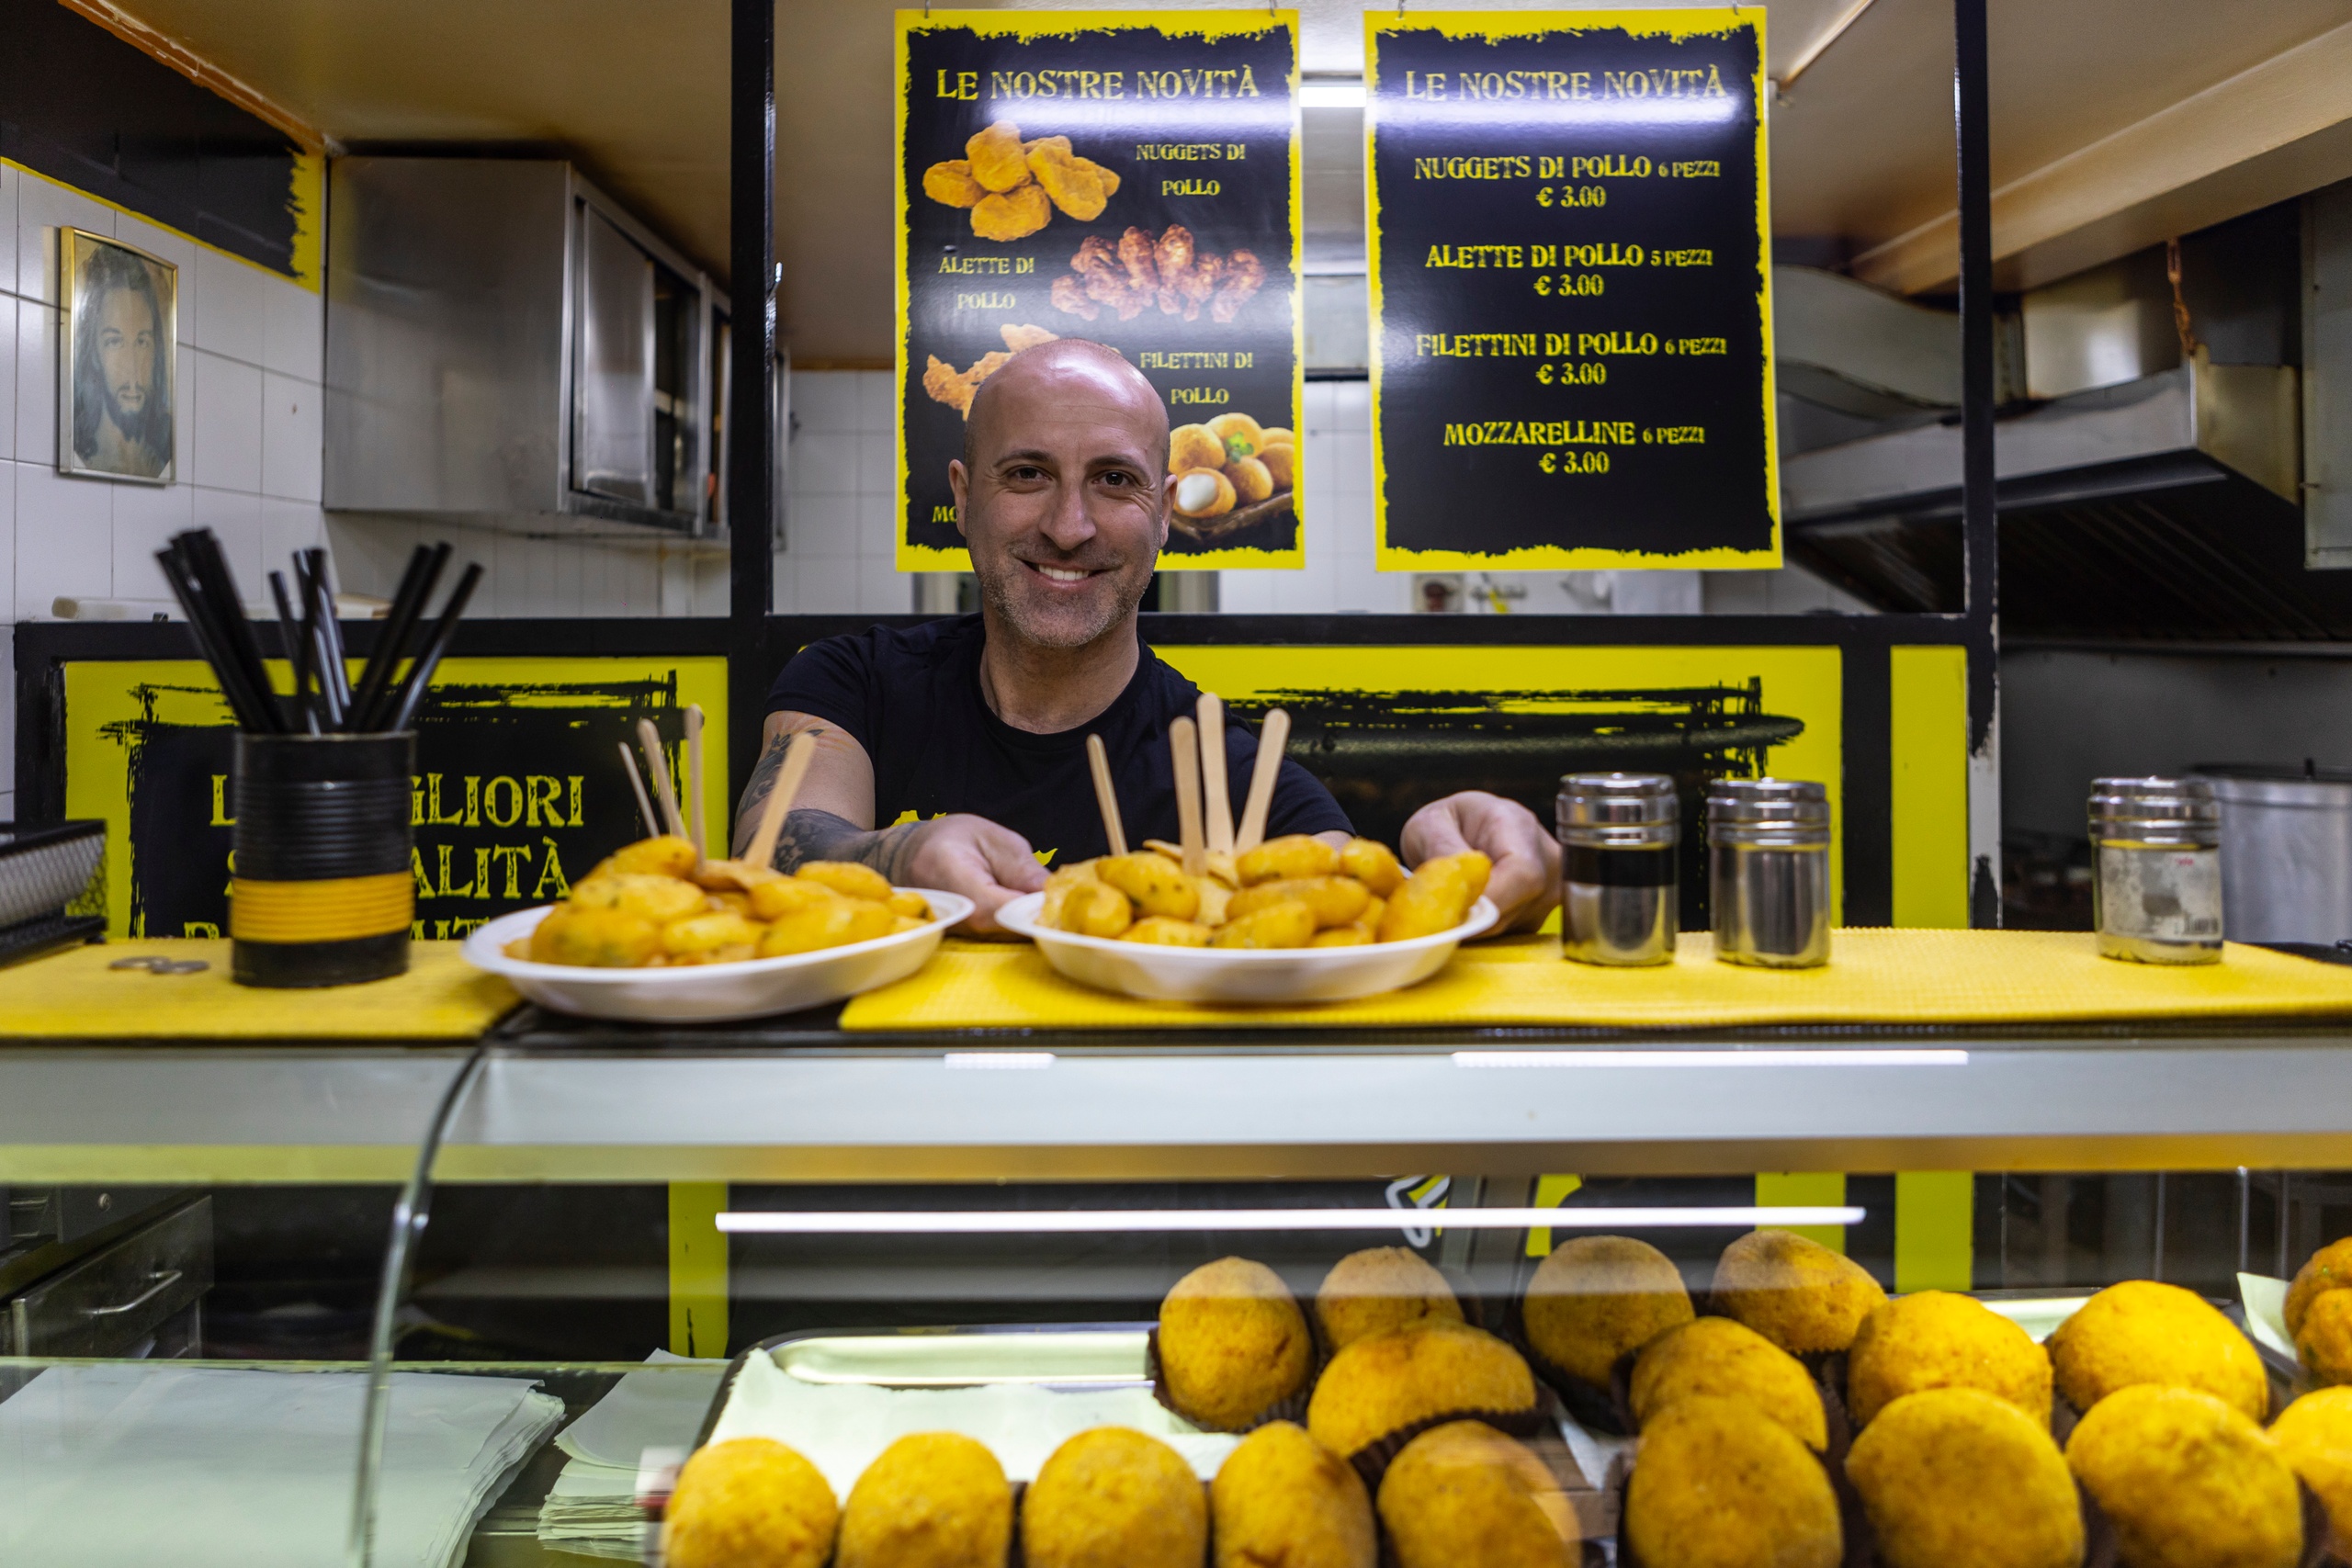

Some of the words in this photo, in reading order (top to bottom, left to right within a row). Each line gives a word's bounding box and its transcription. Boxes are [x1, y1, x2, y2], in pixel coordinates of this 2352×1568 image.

[937, 69, 978, 100] LE
[991, 69, 1124, 100] NOSTRE
[1136, 64, 1260, 99] NOVITÀ
[1406, 71, 1446, 100] LE
[1460, 71, 1590, 100] NOSTRE
[1603, 64, 1726, 98] NOVITÀ
[1136, 143, 1221, 161] NUGGETS
[1227, 144, 1245, 161] DI
[1415, 156, 1531, 179] NUGGETS
[1540, 157, 1564, 178] DI
[1573, 155, 1652, 178] POLLO
[1657, 161, 1669, 178] 6
[1673, 161, 1720, 178] PEZZI
[1162, 179, 1220, 196] POLLO
[1535, 187, 1553, 207] €
[1561, 186, 1606, 207] 3.00
[938, 256, 1010, 274] ALETTE
[1016, 257, 1034, 274] DI
[1426, 244, 1523, 268] ALETTE
[1532, 245, 1556, 267] DI
[1565, 243, 1644, 266] POLLO
[1650, 250, 1661, 265] 5
[1665, 249, 1713, 266] PEZZI
[1533, 276, 1551, 296] €
[1558, 274, 1604, 296] 3.00
[957, 292, 1015, 310] POLLO
[1416, 333, 1537, 357] FILETTINI
[1545, 333, 1570, 356] DI
[1578, 332, 1658, 355] POLLO
[1665, 340, 1676, 355] 6
[1679, 338, 1726, 355] PEZZI
[1140, 352, 1228, 369] FILETTINI
[1235, 353, 1252, 368] DI
[1535, 364, 1553, 384] €
[1561, 362, 1606, 384] 3.00
[1171, 388, 1229, 404] POLLO
[1444, 421, 1635, 446] MOZZARELLINE
[1643, 429, 1653, 444] 6
[1657, 426, 1705, 445] PEZZI
[1538, 453, 1555, 473] €
[1564, 451, 1610, 473] 3.00
